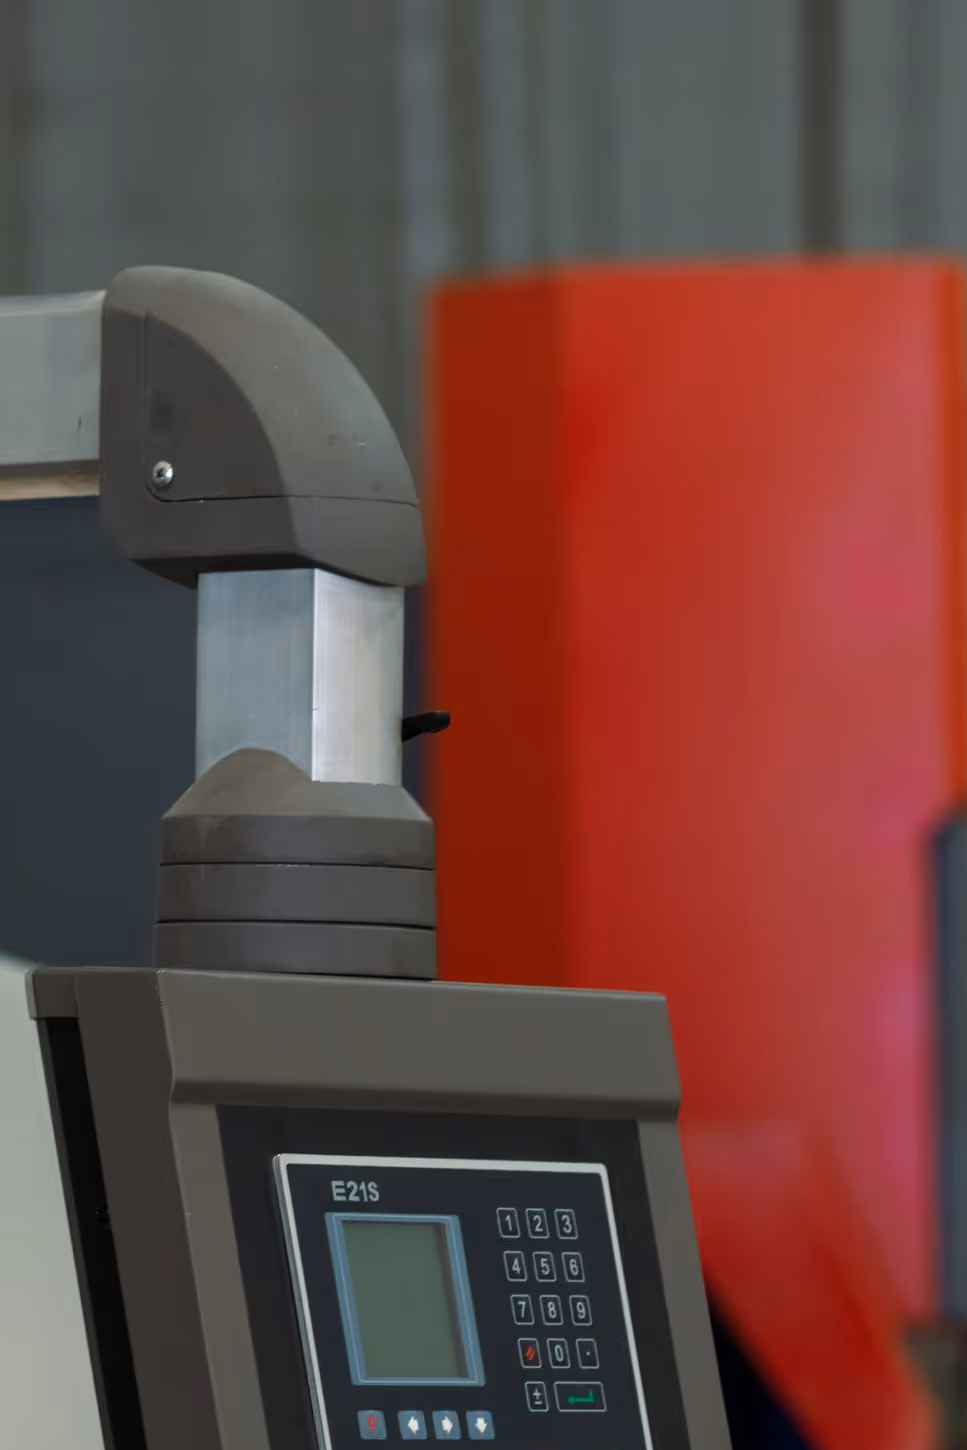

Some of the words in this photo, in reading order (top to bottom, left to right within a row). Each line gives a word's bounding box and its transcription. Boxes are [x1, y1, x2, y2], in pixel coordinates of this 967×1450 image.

[331, 1180, 380, 1202] E21S
[505, 1214, 513, 1232] 1
[533, 1214, 543, 1232] 2
[561, 1214, 572, 1233] 3
[512, 1258, 521, 1274] 4
[540, 1258, 550, 1275] 5
[569, 1259, 579, 1275] 6
[517, 1301, 526, 1318] 7
[547, 1301, 557, 1318] 8
[576, 1301, 586, 1319] 9
[554, 1344, 564, 1362] 0
